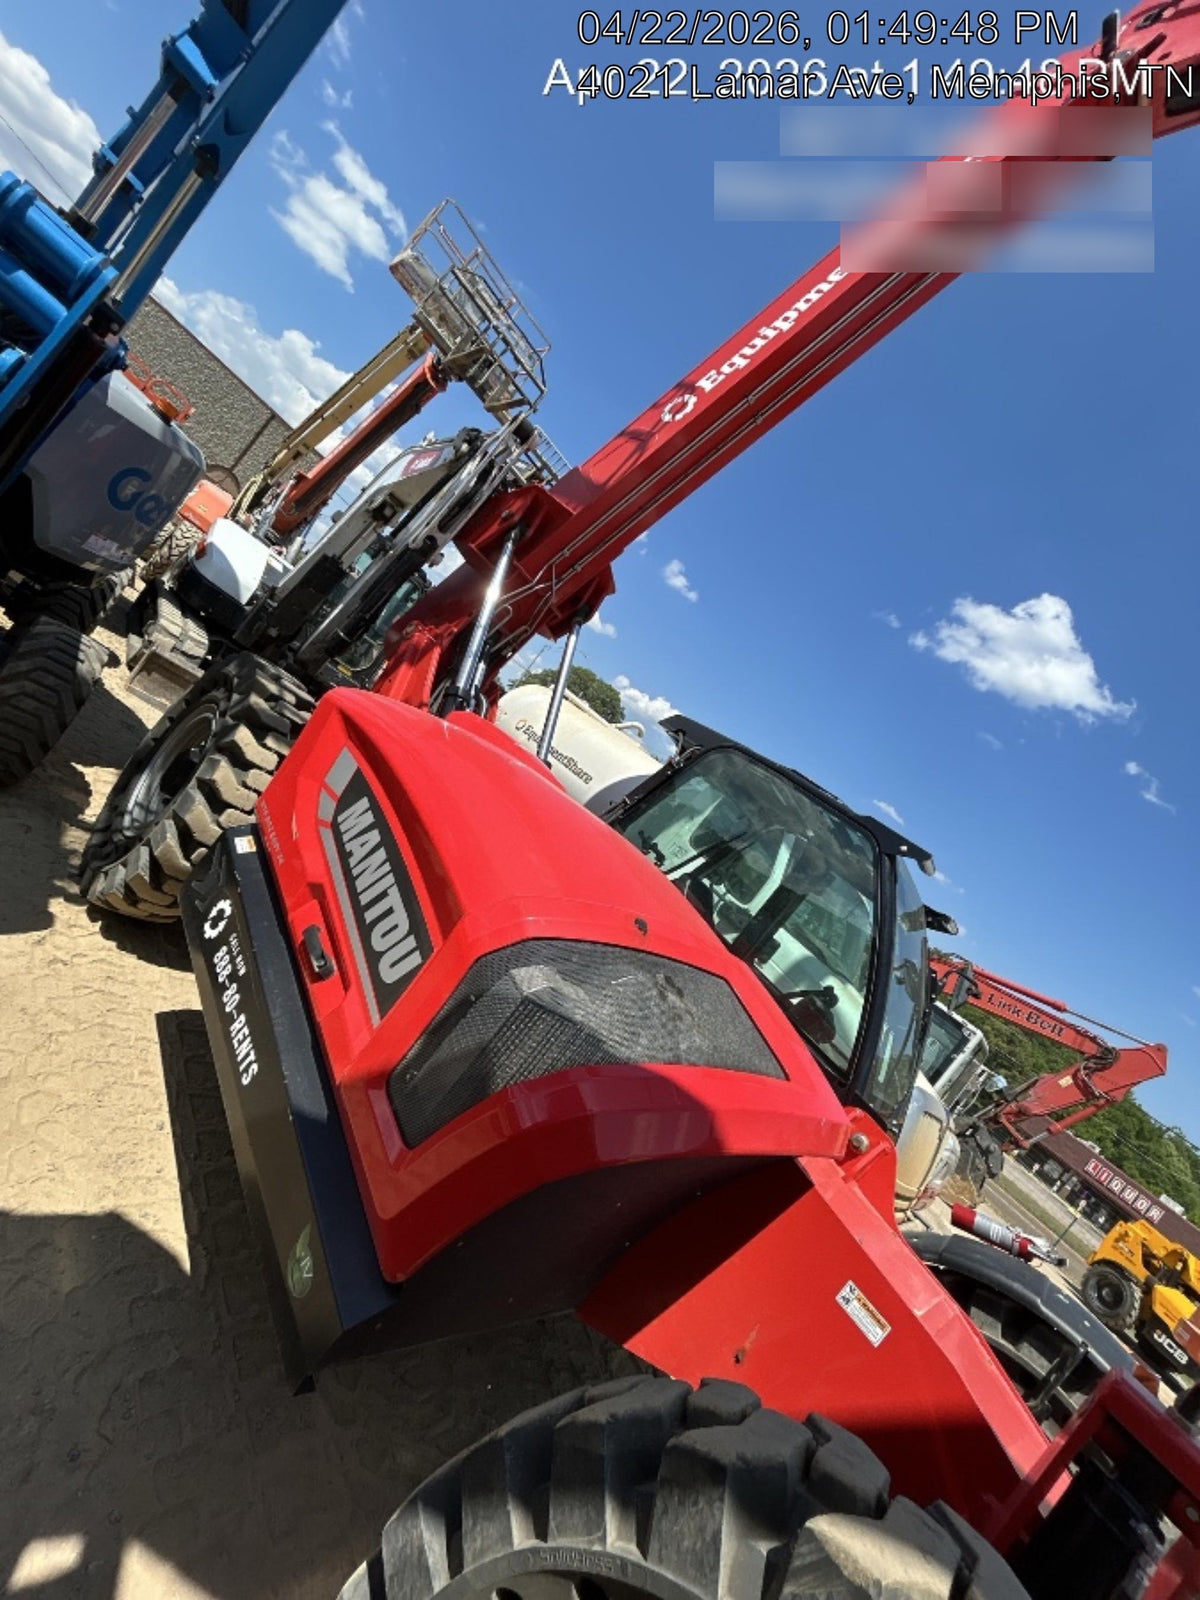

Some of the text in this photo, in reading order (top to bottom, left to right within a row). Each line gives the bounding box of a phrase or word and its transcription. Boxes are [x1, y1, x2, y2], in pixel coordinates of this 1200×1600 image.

[337, 796, 423, 984] MANITOU
[213, 945, 259, 1086] 888-80-RENTS
[1084, 1159, 1165, 1224] LIQUOR
[1153, 1331, 1189, 1365] JCB
